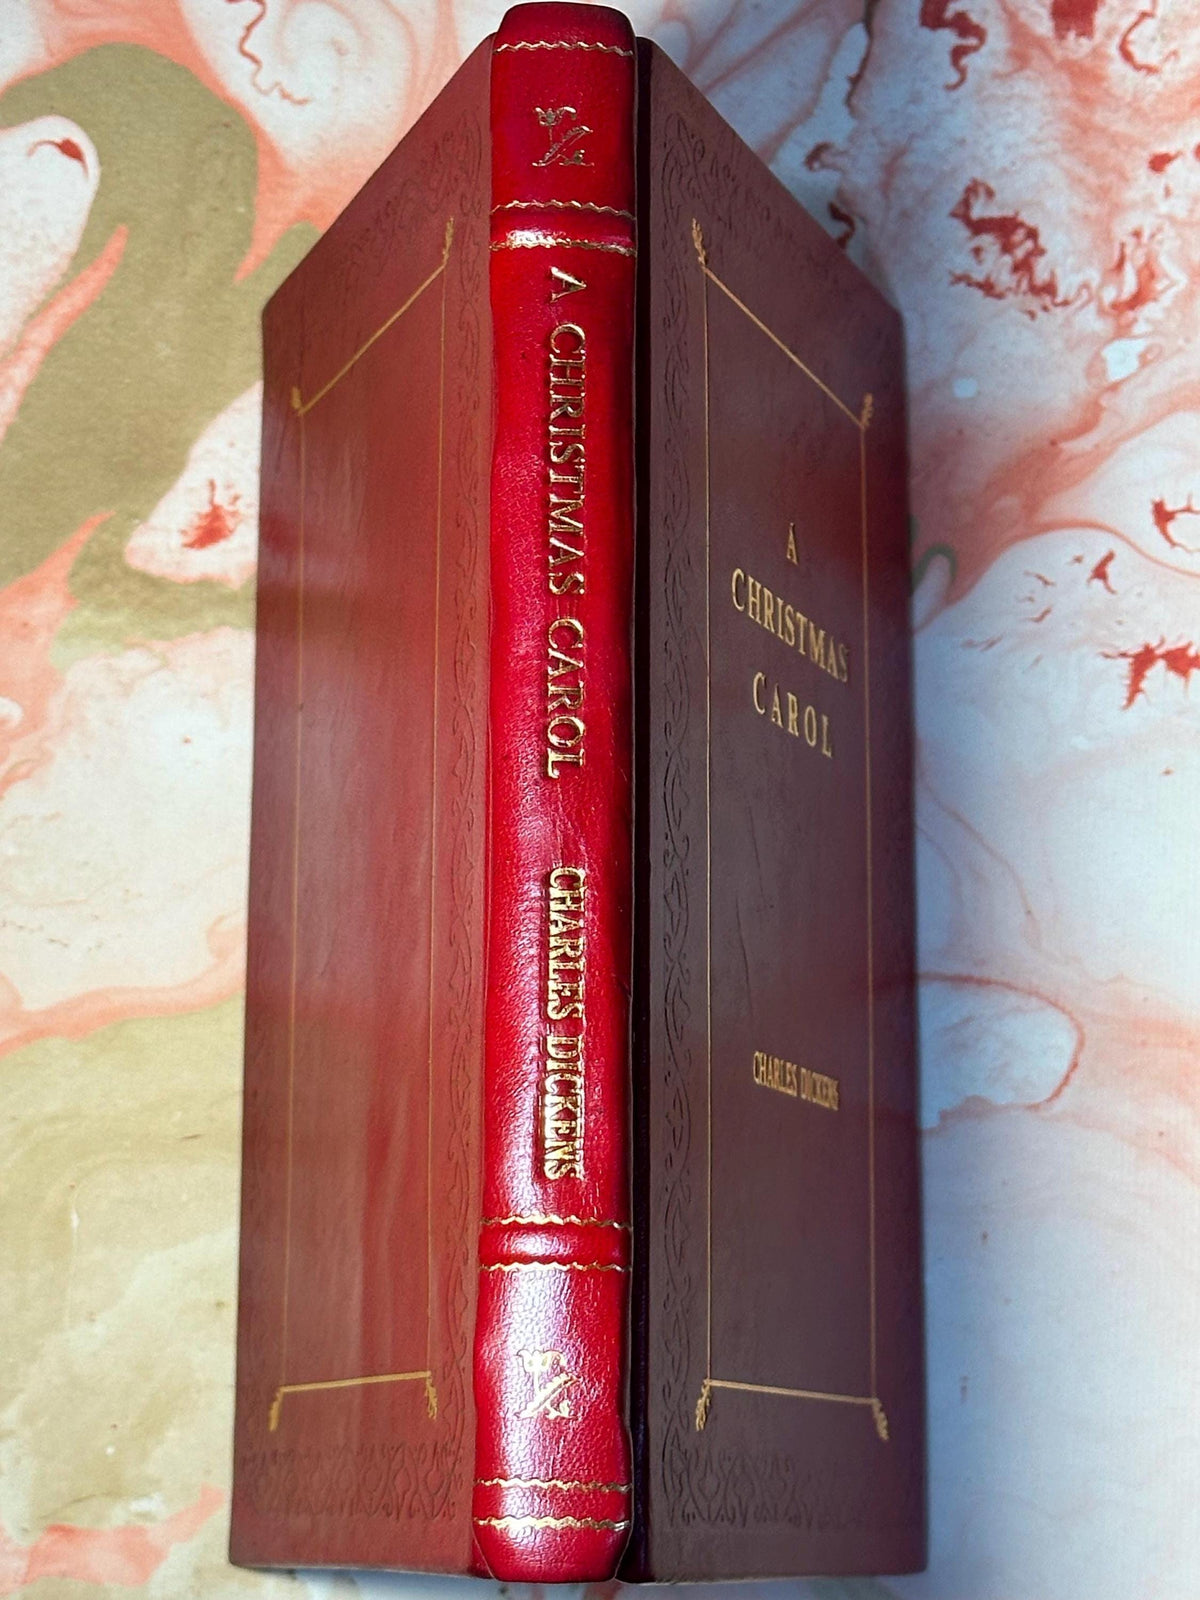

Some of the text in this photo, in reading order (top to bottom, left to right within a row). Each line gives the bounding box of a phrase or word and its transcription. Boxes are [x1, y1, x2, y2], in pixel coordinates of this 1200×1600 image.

[547, 265, 587, 779] A CHRISTMAS CAROL
[786, 522, 799, 566] A
[731, 567, 849, 683] CHRISTMAS
[753, 671, 832, 759] CAROL
[543, 866, 588, 1181] CHARLES DICKENS
[753, 1050, 798, 1098] CHARLES
